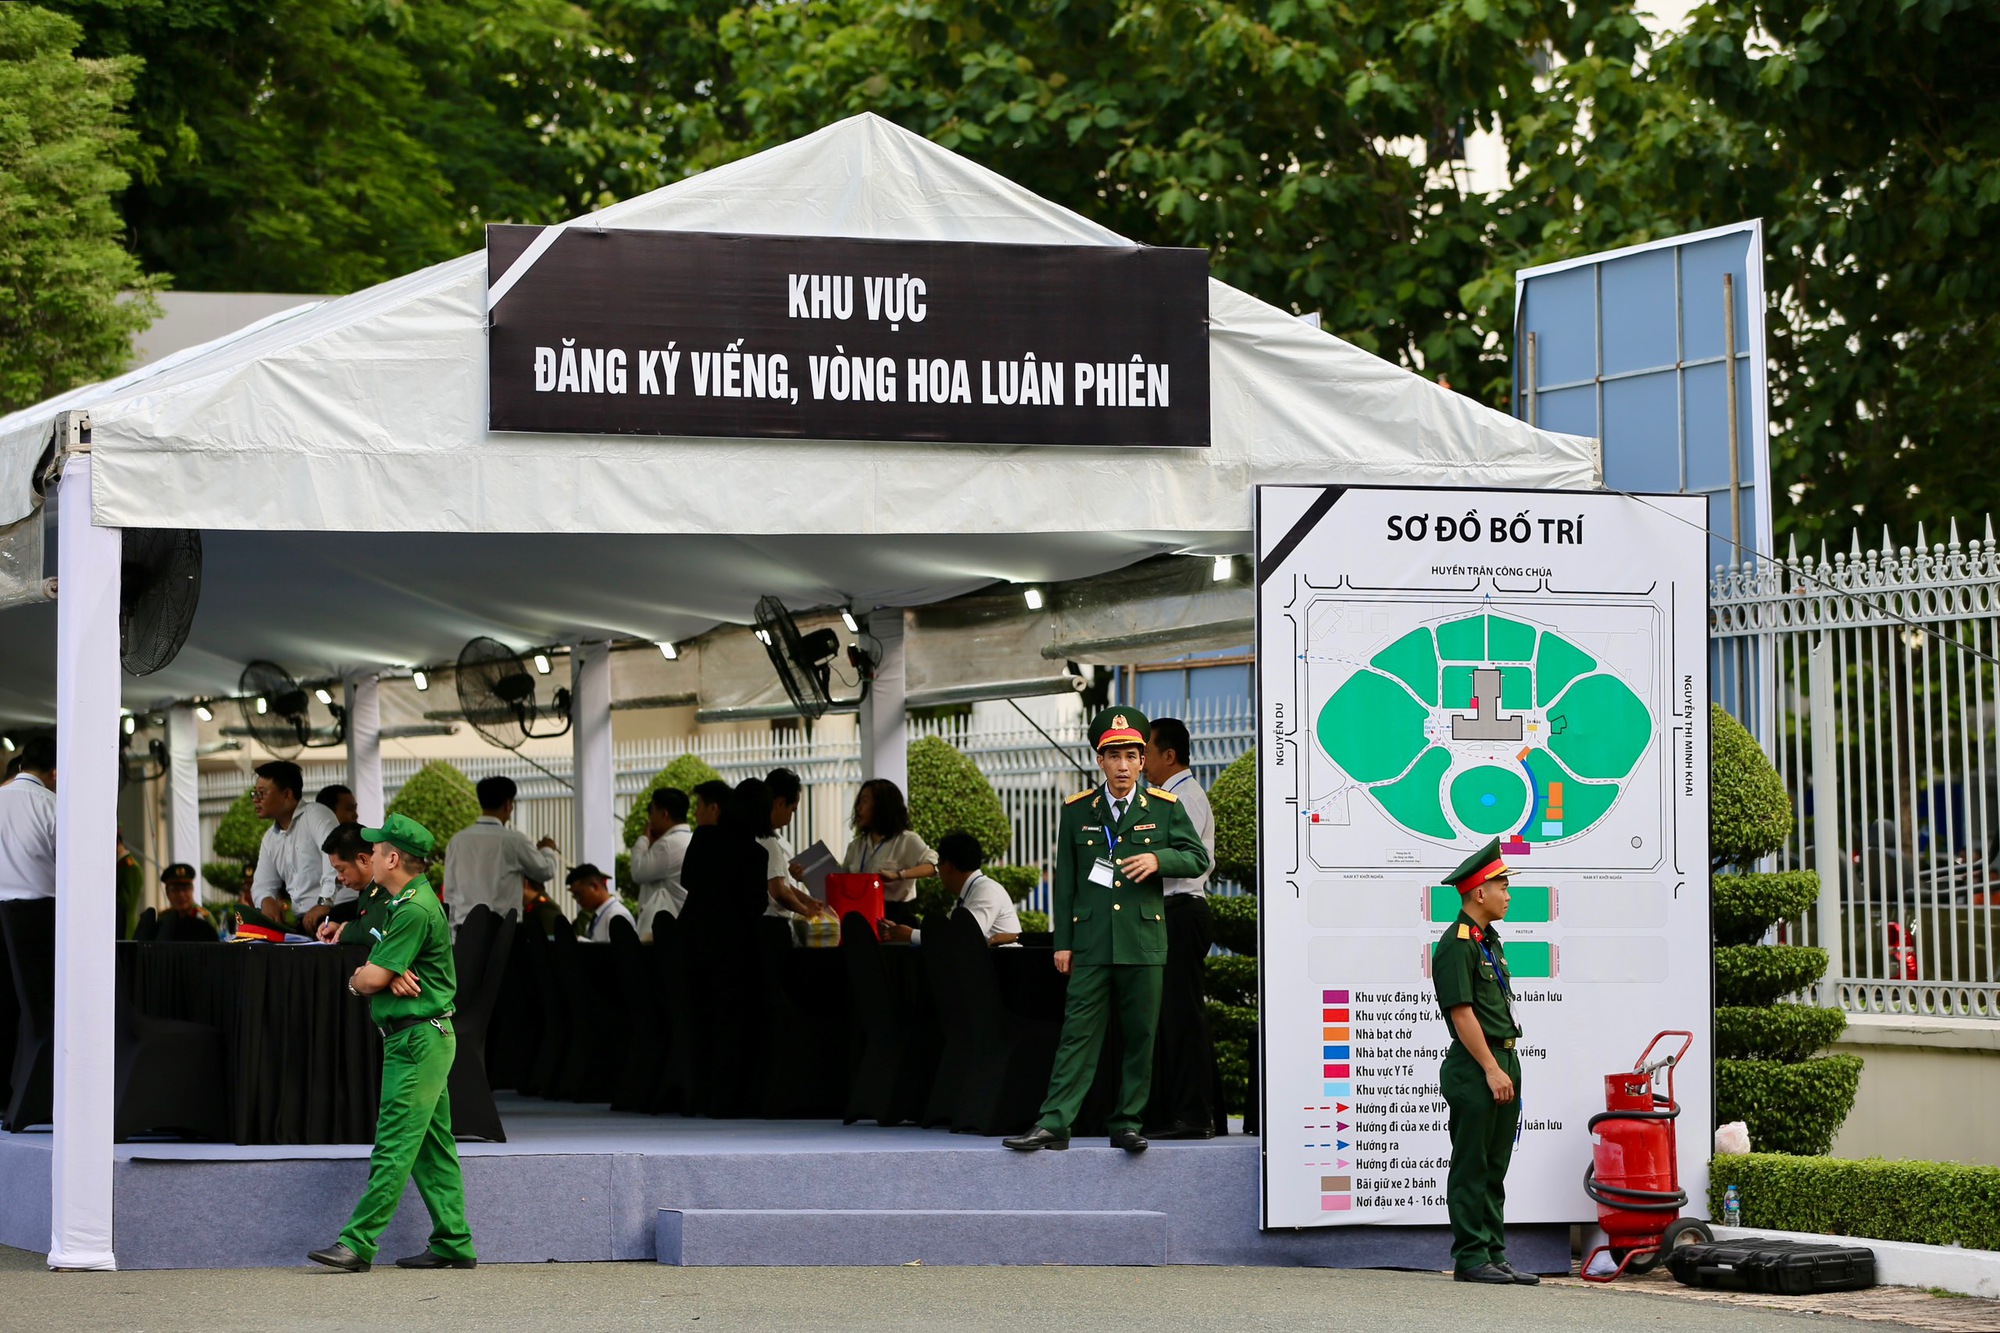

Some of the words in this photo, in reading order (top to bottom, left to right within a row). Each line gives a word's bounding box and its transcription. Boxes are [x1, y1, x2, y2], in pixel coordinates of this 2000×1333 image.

[788, 273, 854, 321] KHU
[863, 272, 928, 332] VỰC
[533, 336, 628, 395] ĐĂNG
[637, 340, 682, 396] KÝ
[690, 337, 799, 405] VIẾNG,
[808, 344, 897, 402] VÒNG
[907, 357, 973, 404] HOA
[981, 351, 1065, 406] LUÂN
[1074, 353, 1170, 408] PHIÊN
[1386, 512, 1429, 542] SƠ
[1434, 508, 1482, 543] ĐỒ
[1489, 509, 1532, 544] BỐ
[1537, 513, 1585, 545] TRÍ
[1467, 564, 1493, 576] TRÂN
[1495, 565, 1524, 577] CÔNG
[1525, 566, 1553, 578] CHÚA
[1275, 702, 1284, 719] DU
[1682, 720, 1693, 738] THỊ
[1685, 740, 1693, 769] MINH
[1685, 771, 1693, 797] KHAI
[1355, 991, 1374, 1002] Khu
[1376, 993, 1392, 1005] vực
[1394, 991, 1419, 1005] đăng
[1421, 991, 1432, 1005] ký
[1524, 990, 1545, 1002] luân
[1547, 990, 1562, 1002] lưu
[1355, 1010, 1374, 1021] Khu
[1376, 1011, 1392, 1024] vực
[1355, 1028, 1374, 1040] Nhà
[1377, 1028, 1393, 1042] bạt
[1395, 1028, 1412, 1040] chờ
[1355, 1047, 1374, 1058] Nhà
[1377, 1047, 1393, 1061] bạt
[1395, 1046, 1412, 1058] che
[1414, 1045, 1438, 1060] nắng
[1520, 1044, 1547, 1060] viếng
[1355, 1065, 1375, 1077] Khu
[1377, 1067, 1393, 1080] vực
[1394, 1065, 1401, 1077] Y
[1402, 1063, 1415, 1076] Tế
[1356, 1084, 1375, 1095] Khu
[1377, 1085, 1393, 1098] vực
[1395, 1083, 1410, 1095] tác
[1355, 1102, 1387, 1116] Hướng
[1389, 1102, 1398, 1113] đi
[1400, 1101, 1417, 1113] của
[1419, 1104, 1430, 1113] xe
[1431, 1101, 1448, 1113] VIP
[1355, 1121, 1387, 1135] Hướng
[1389, 1120, 1398, 1132] đi
[1400, 1120, 1417, 1132] của
[1419, 1123, 1430, 1132] xe
[1431, 1120, 1441, 1132] di
[1524, 1119, 1545, 1130] luân
[1547, 1119, 1563, 1130] lưu
[1356, 1139, 1387, 1154] Hướng
[1389, 1142, 1399, 1151] ra
[1356, 1158, 1387, 1172] Hướng
[1389, 1158, 1399, 1169] đi
[1400, 1157, 1417, 1169] của
[1419, 1157, 1434, 1169] các
[1356, 1178, 1372, 1190] Bãi
[1374, 1178, 1390, 1192] giữ
[1391, 1180, 1402, 1189] xe
[1404, 1178, 1410, 1189] 2
[1412, 1177, 1437, 1188] bánh
[1356, 1195, 1372, 1207] Nơi
[1374, 1195, 1392, 1210] đậu
[1394, 1198, 1406, 1207] xe
[1407, 1195, 1414, 1206] 4
[1421, 1195, 1433, 1206] 16
[1435, 1195, 1448, 1206] ch
